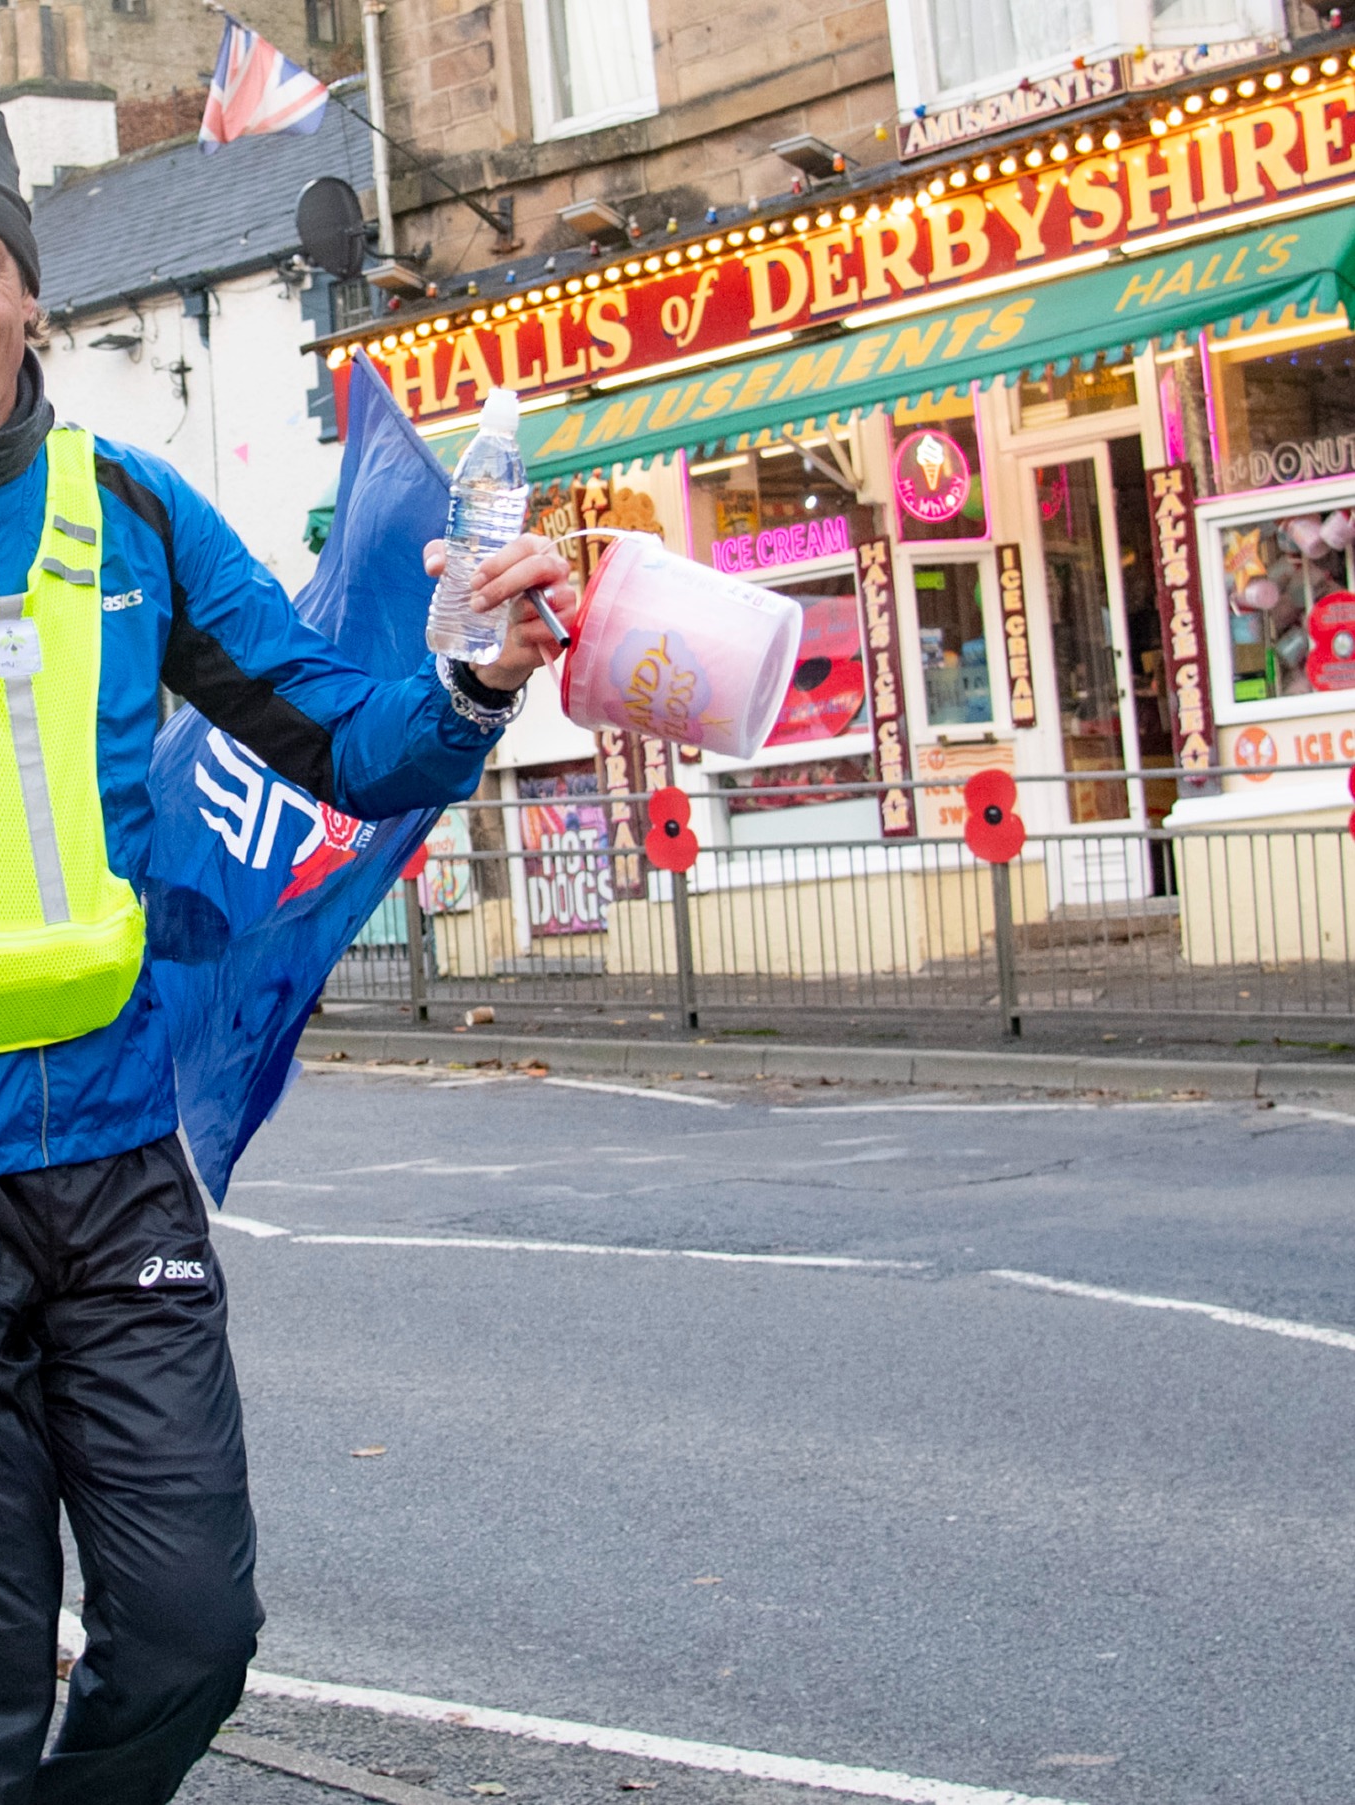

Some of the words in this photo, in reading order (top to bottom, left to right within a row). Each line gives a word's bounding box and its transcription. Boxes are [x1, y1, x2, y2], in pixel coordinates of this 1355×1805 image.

[1132, 51, 1185, 87] ICE
[384, 292, 633, 418] HALL'S
[660, 267, 719, 349] of
[743, 84, 1355, 331] DERBYSHIRE
[534, 297, 1036, 458] AMUSEMENTS
[1114, 233, 1300, 313] HALL'S
[918, 475, 965, 516] Whipy
[1151, 469, 1190, 587] HALLS
[711, 533, 756, 574] ICE
[755, 515, 850, 568] CREAM
[102, 588, 144, 612] asics
[858, 541, 891, 649] HALLS
[1000, 548, 1023, 612] ICE
[1169, 588, 1199, 661] ICE
[874, 651, 898, 719] ICE
[1005, 614, 1034, 720] CREAM
[877, 720, 910, 831] CREAM
[1293, 731, 1335, 764] ICE
[540, 828, 598, 876] HOT
[163, 1259, 205, 1279] asics
